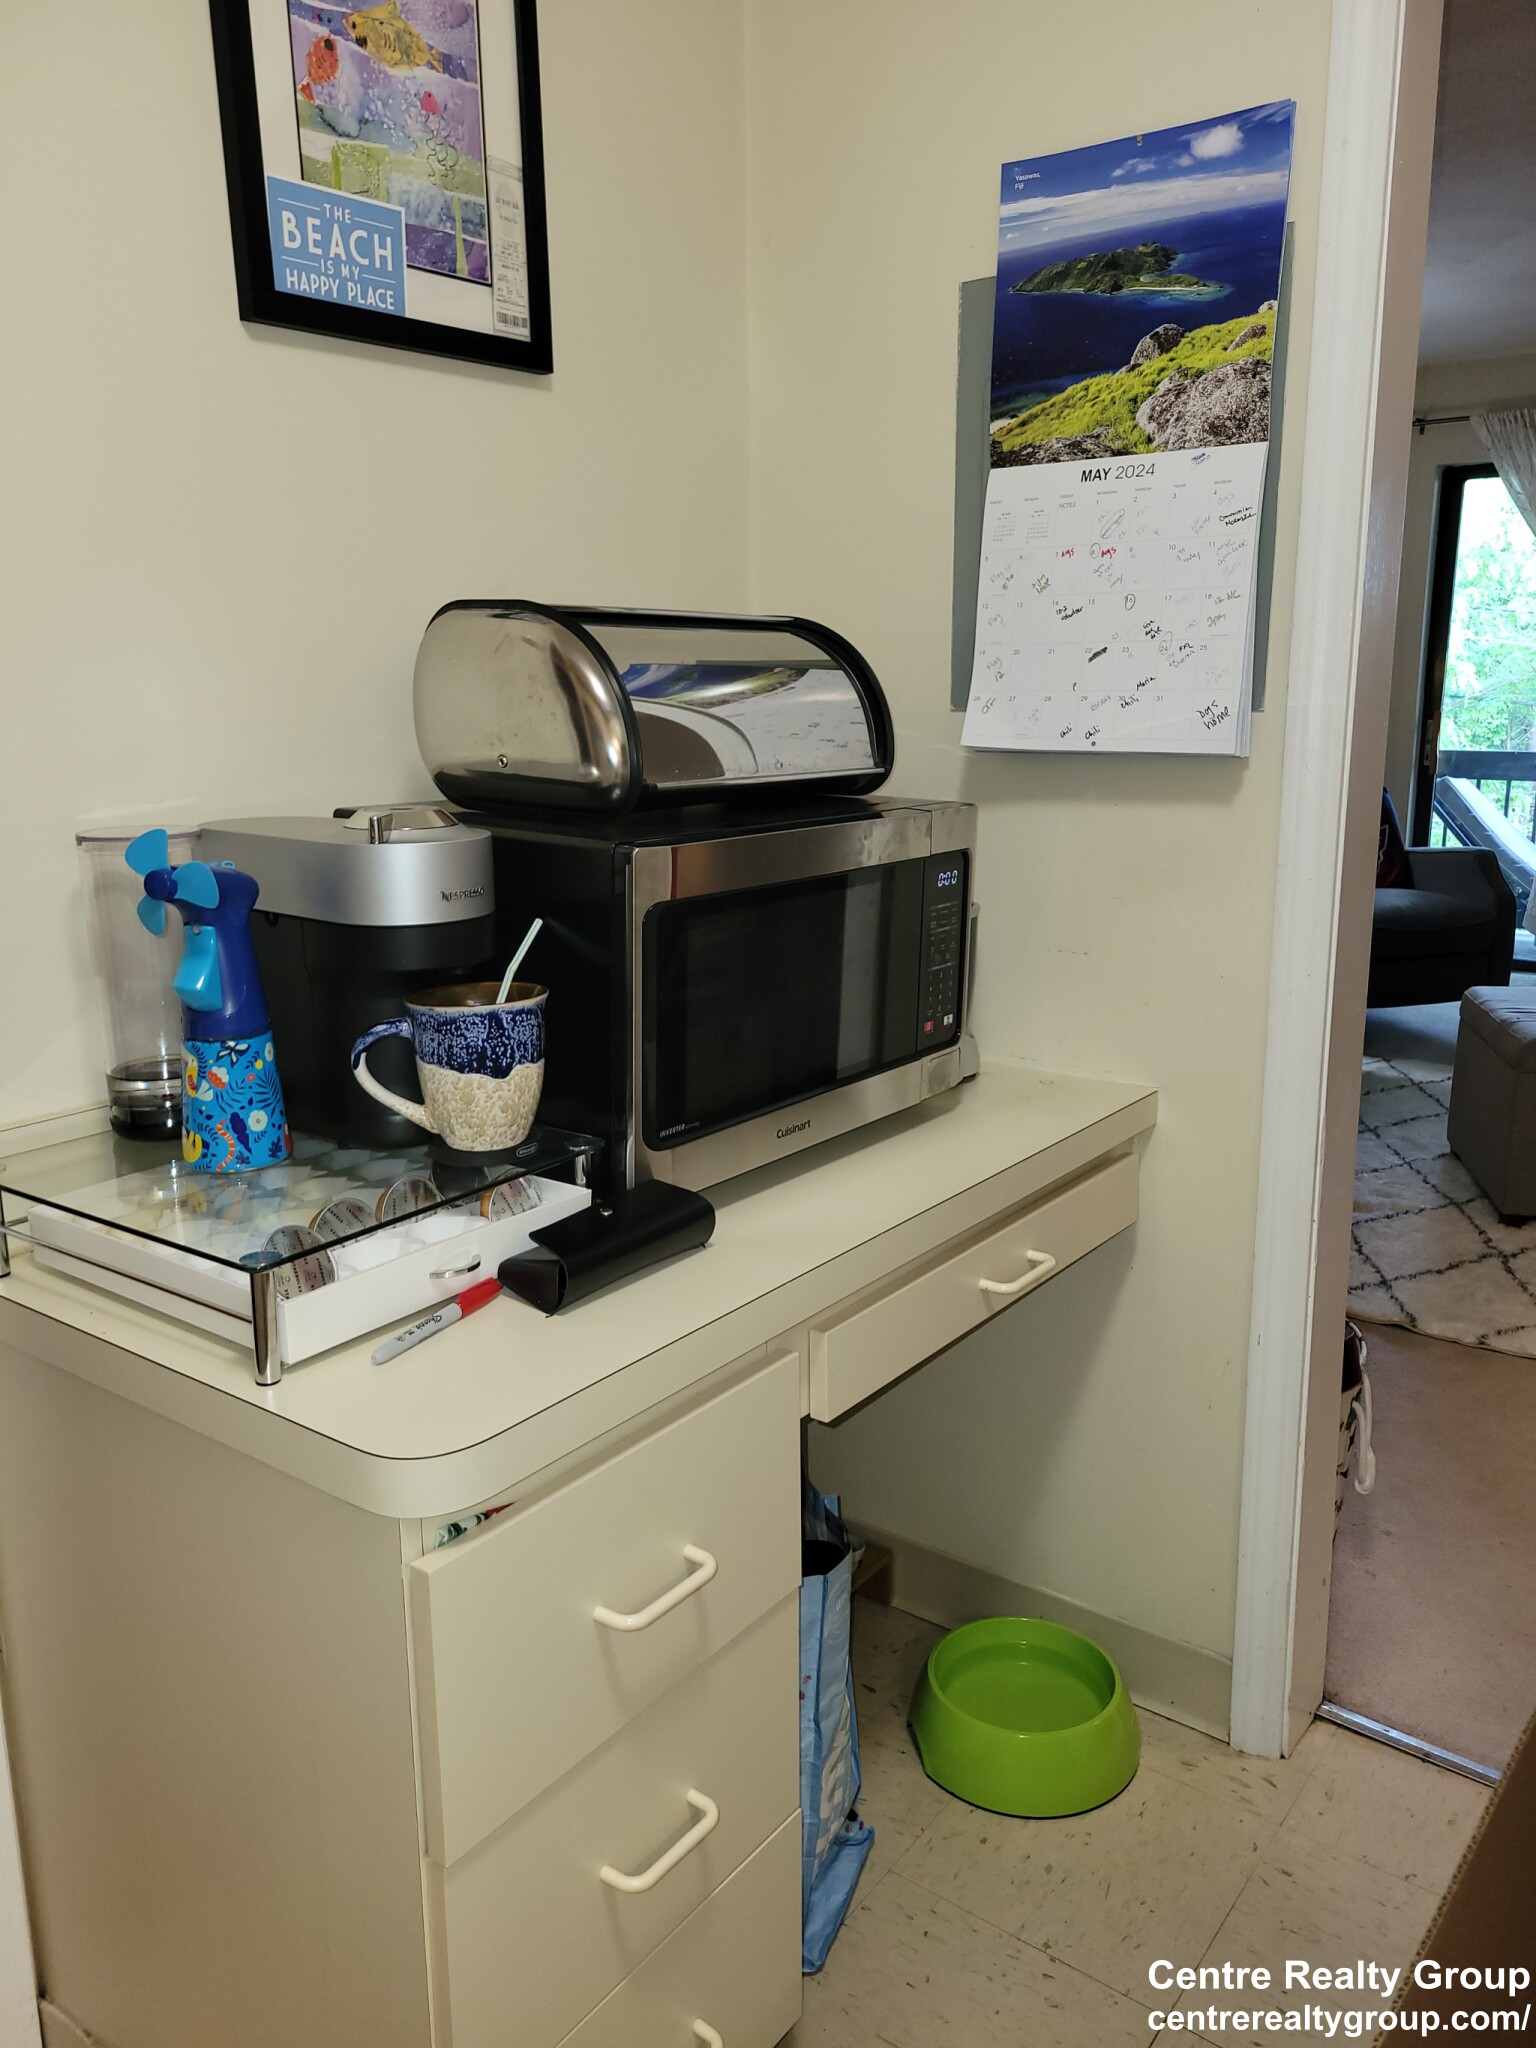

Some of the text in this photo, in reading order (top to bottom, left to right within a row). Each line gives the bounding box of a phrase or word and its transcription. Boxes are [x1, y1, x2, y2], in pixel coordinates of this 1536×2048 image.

[323, 203, 351, 223] THE
[281, 210, 393, 272] BEACH
[321, 258, 360, 280] IS MY
[285, 267, 395, 310] HAPPY PLACE
[1080, 463, 1155, 482] MAY 2024
[1203, 706, 1231, 730] home
[440, 887, 485, 903] NESPRESSO
[659, 1123, 686, 1138] INVERTER
[776, 1119, 811, 1139] Cuisinart
